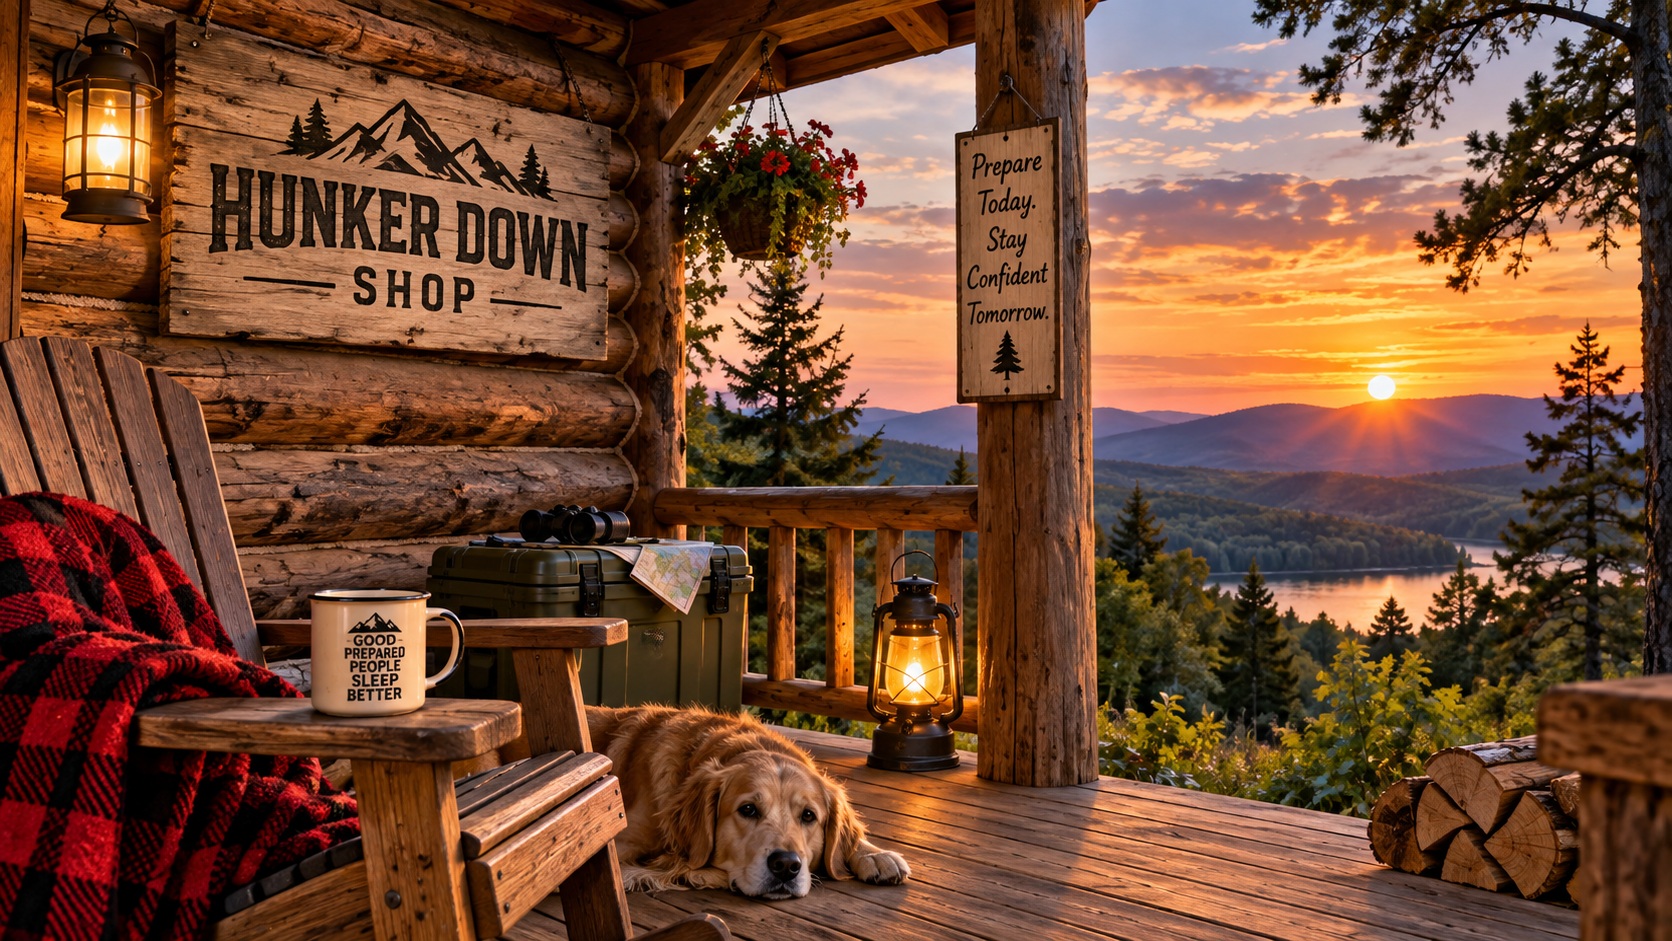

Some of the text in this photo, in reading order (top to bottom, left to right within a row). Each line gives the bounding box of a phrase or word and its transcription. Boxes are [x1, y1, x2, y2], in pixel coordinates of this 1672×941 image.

[972, 153, 1042, 184] Prepare
[978, 187, 1036, 219] Today.
[209, 163, 588, 292] HUNKER DOWN
[987, 226, 1027, 258] Stay
[353, 266, 475, 313] SHOP
[967, 262, 1048, 294] Confident
[967, 301, 1049, 325] Tomorrow.
[344, 646, 405, 659] PREPARED
[353, 634, 396, 646] GOOD
[350, 660, 401, 672] PEOPLE
[352, 673, 399, 687] SLEEP
[347, 687, 402, 701] BETTER
